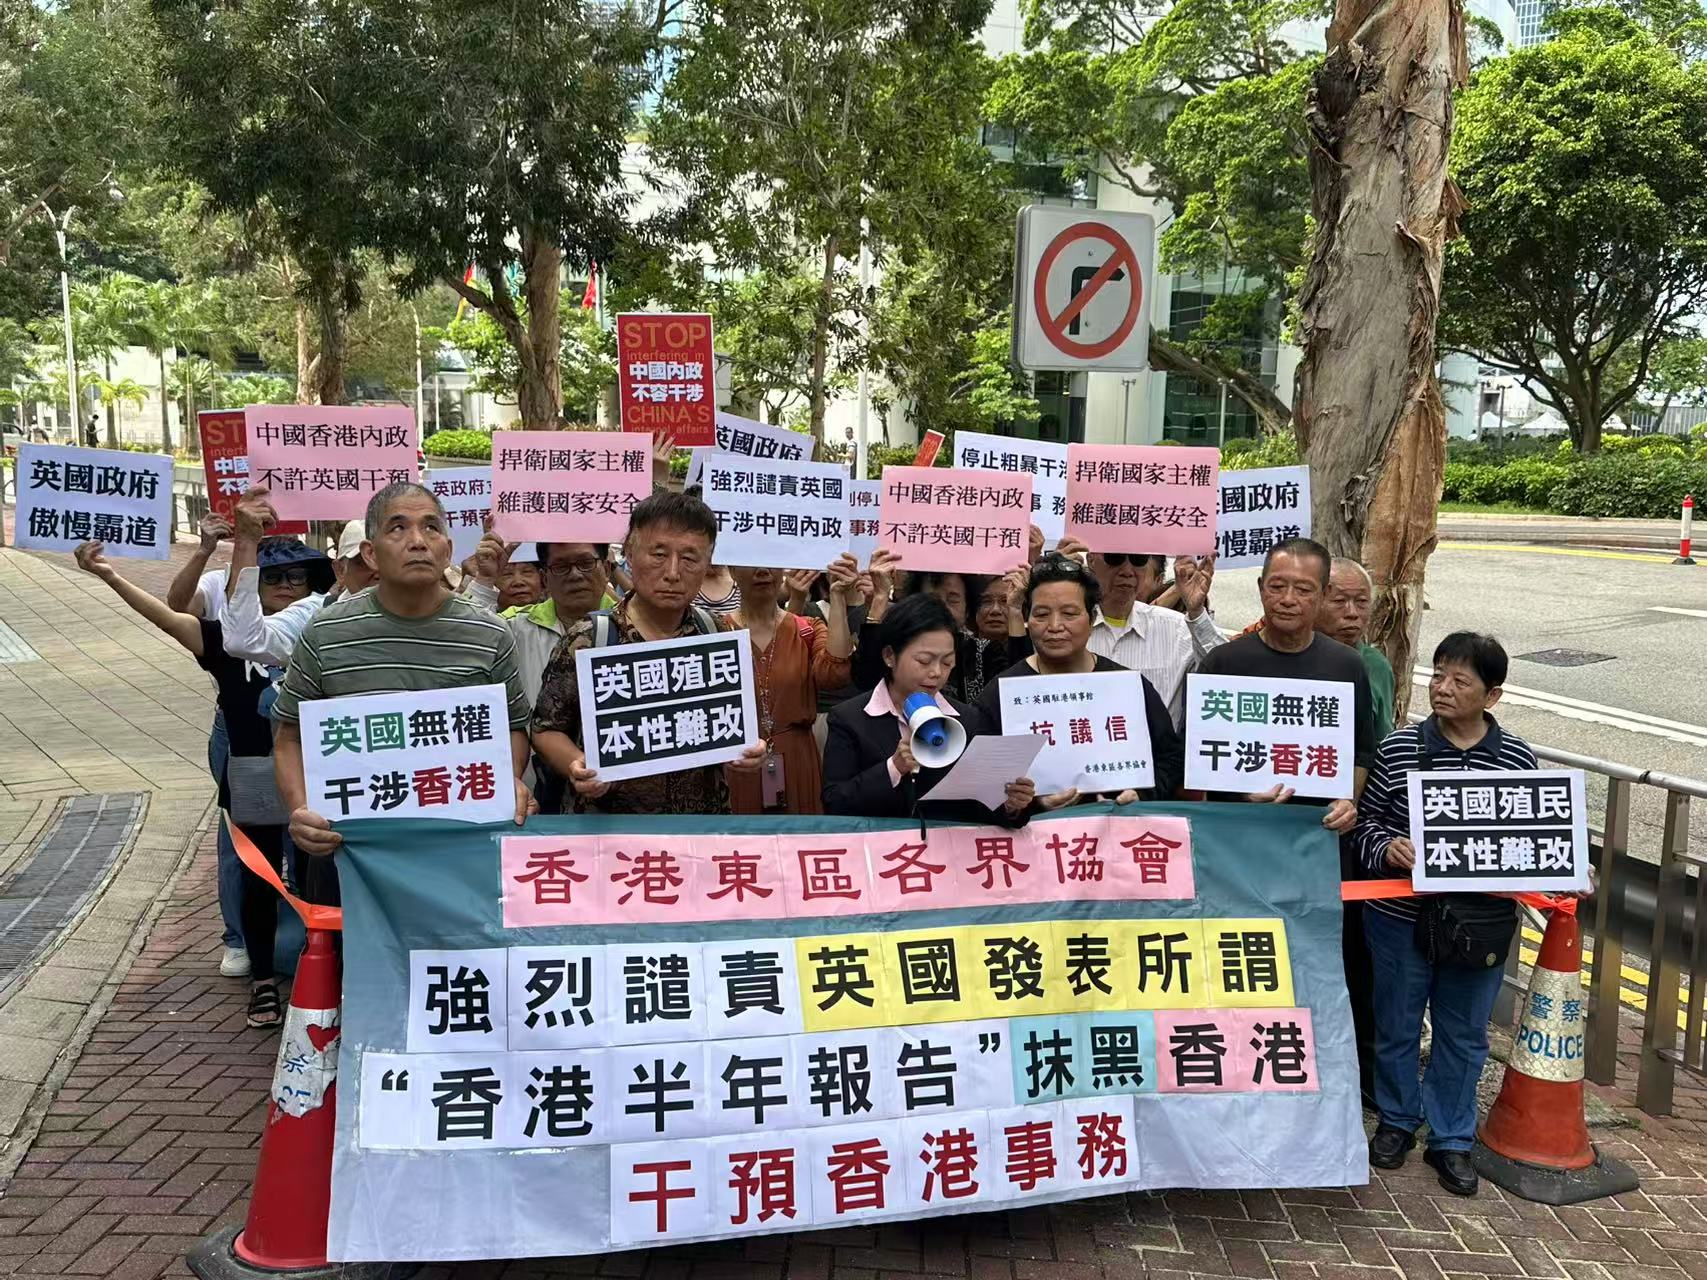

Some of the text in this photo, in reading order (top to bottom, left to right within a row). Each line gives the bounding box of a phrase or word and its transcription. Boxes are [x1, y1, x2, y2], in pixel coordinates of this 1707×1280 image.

[624, 322, 706, 348] STOP
[627, 349, 688, 361] interfering
[629, 361, 703, 380] 中國內政
[631, 383, 704, 402] 不容干涉
[627, 405, 710, 423] CHINA'S
[676, 424, 708, 433] affairs
[256, 422, 409, 449] 中國香港內政
[499, 449, 645, 473] 捍衛國家主權
[1076, 460, 1212, 487] 捍衛國家主權
[30, 459, 160, 500] 英國政府
[256, 467, 410, 491] 不許英國干預
[432, 479, 491, 496] 英政府
[711, 469, 842, 500] 強烈譴責英國
[497, 491, 641, 515] 維護國家安全
[889, 482, 1024, 509] 中國香港內政
[1217, 481, 1299, 514] 國政府
[28, 507, 158, 547] 傲慢霸道
[713, 510, 842, 538] 干涉中國內政
[1071, 502, 1208, 528] 維護國家安全
[885, 522, 1022, 549] 不許英國干預
[1214, 525, 1300, 559] 慢霸道
[594, 649, 740, 702] 英國殖民
[1201, 689, 1340, 727] 英國無權
[319, 703, 493, 756] 英國無權
[599, 704, 743, 759] 本性難改
[1199, 740, 1339, 778] 干涉香港
[324, 762, 495, 815] 干涉香港
[1424, 785, 1572, 821] 英國殖民
[513, 831, 1182, 905] 香港東區各界協會
[1425, 837, 1573, 872] 本性難改
[425, 931, 1279, 1036] 強烈譴責英國發表所謂
[1531, 991, 1581, 1022] 警察
[1518, 1023, 1583, 1059] POLICE
[629, 1112, 1128, 1233] 干預香港事務
